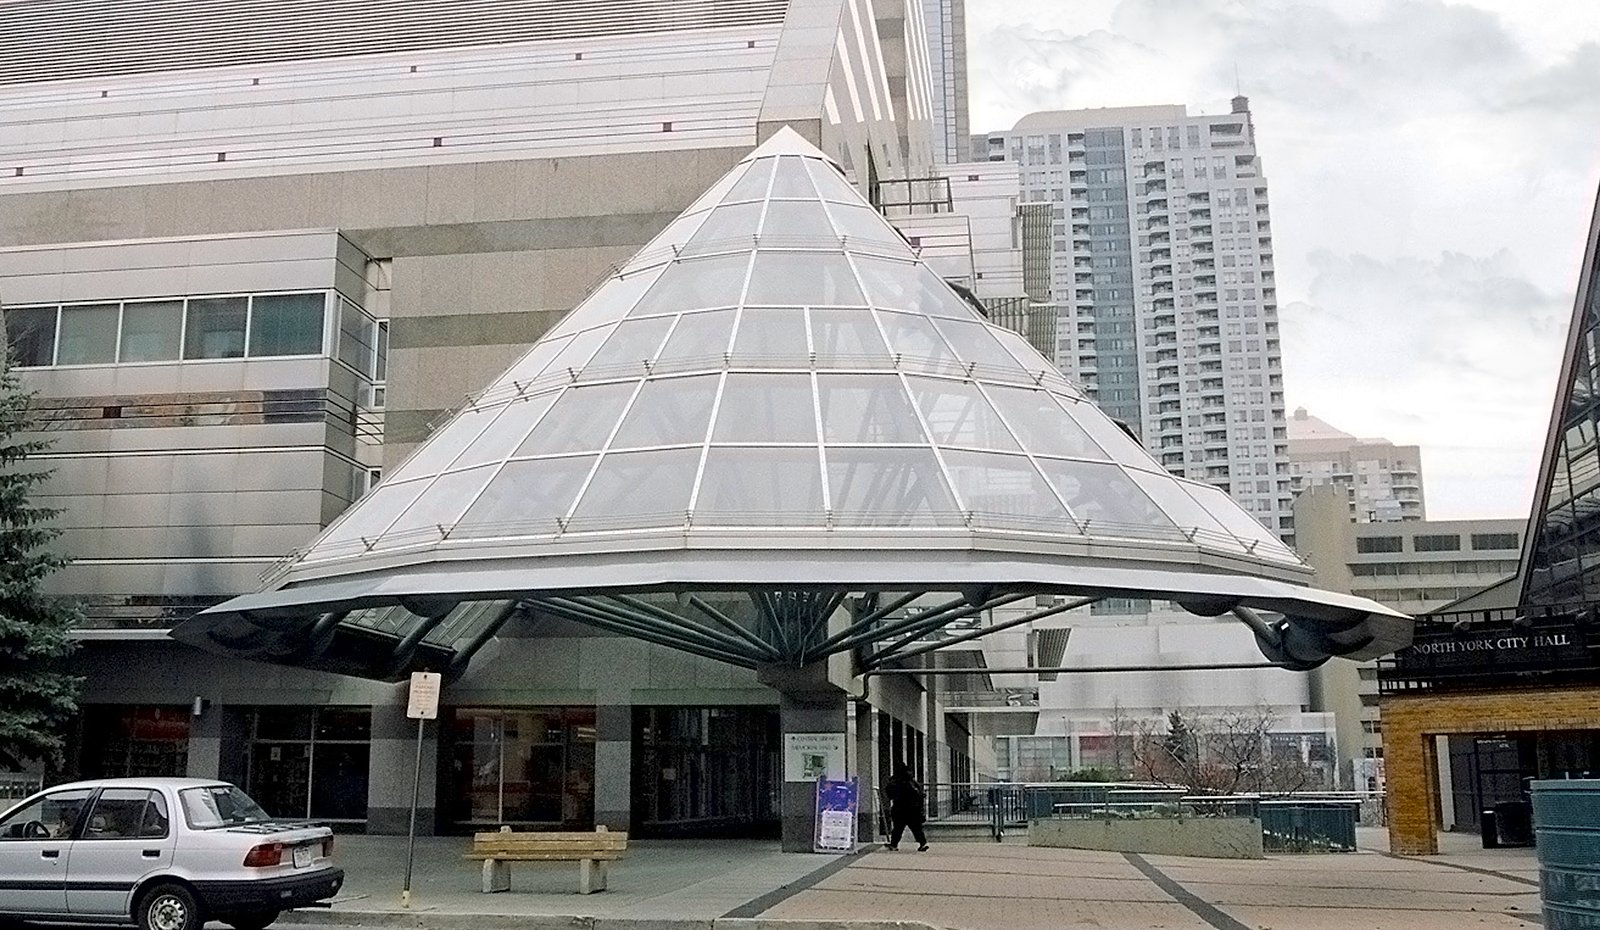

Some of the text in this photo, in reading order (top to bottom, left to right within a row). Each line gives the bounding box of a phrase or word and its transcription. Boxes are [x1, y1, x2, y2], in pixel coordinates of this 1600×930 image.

[1413, 634, 1571, 653] NORTH YORK CITY HALL
